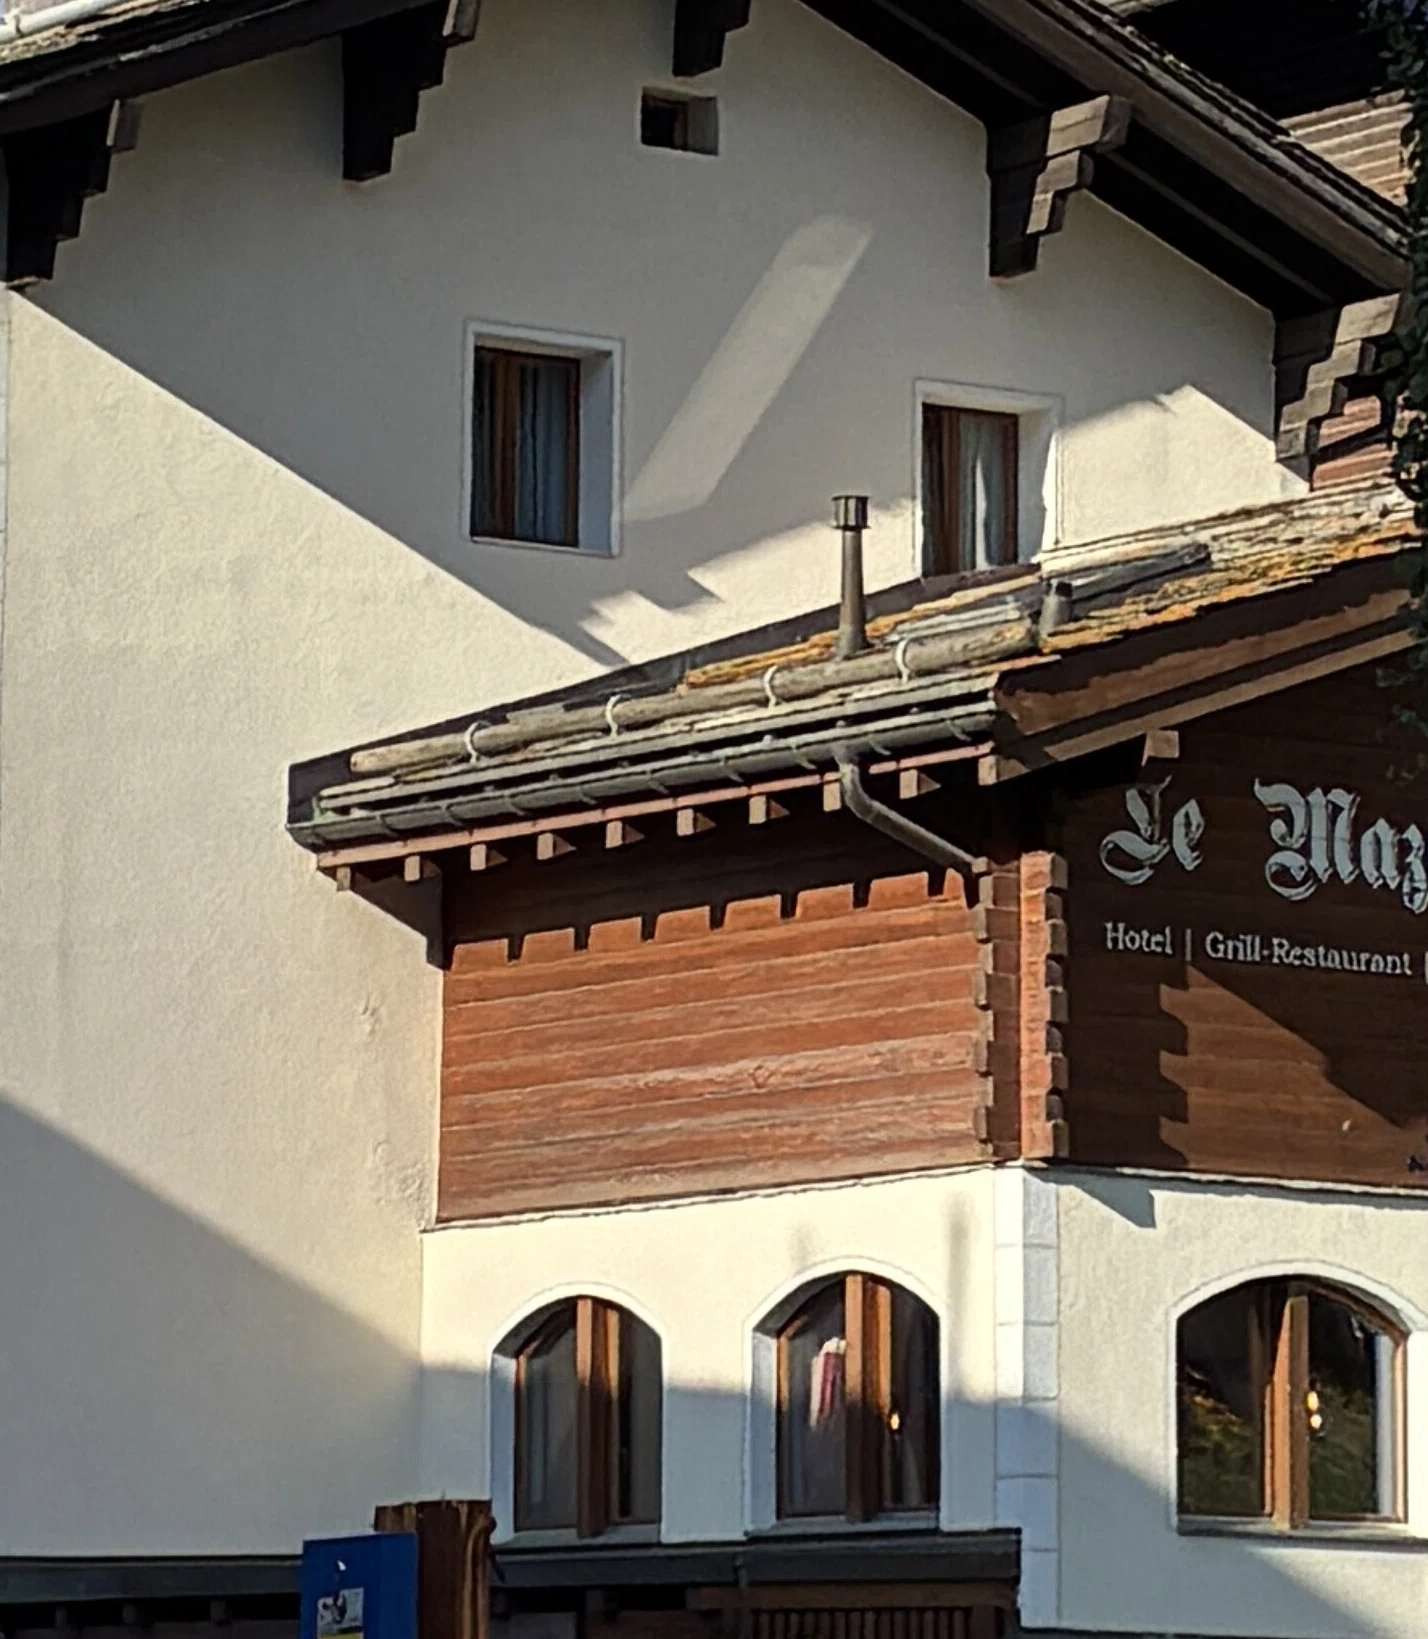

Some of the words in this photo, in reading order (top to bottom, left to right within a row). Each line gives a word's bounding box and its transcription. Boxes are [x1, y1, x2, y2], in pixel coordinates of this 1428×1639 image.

[1100, 775, 1204, 886] Le
[1104, 922, 1173, 955] Hotel
[1204, 930, 1414, 977] Grill-Restaurant
